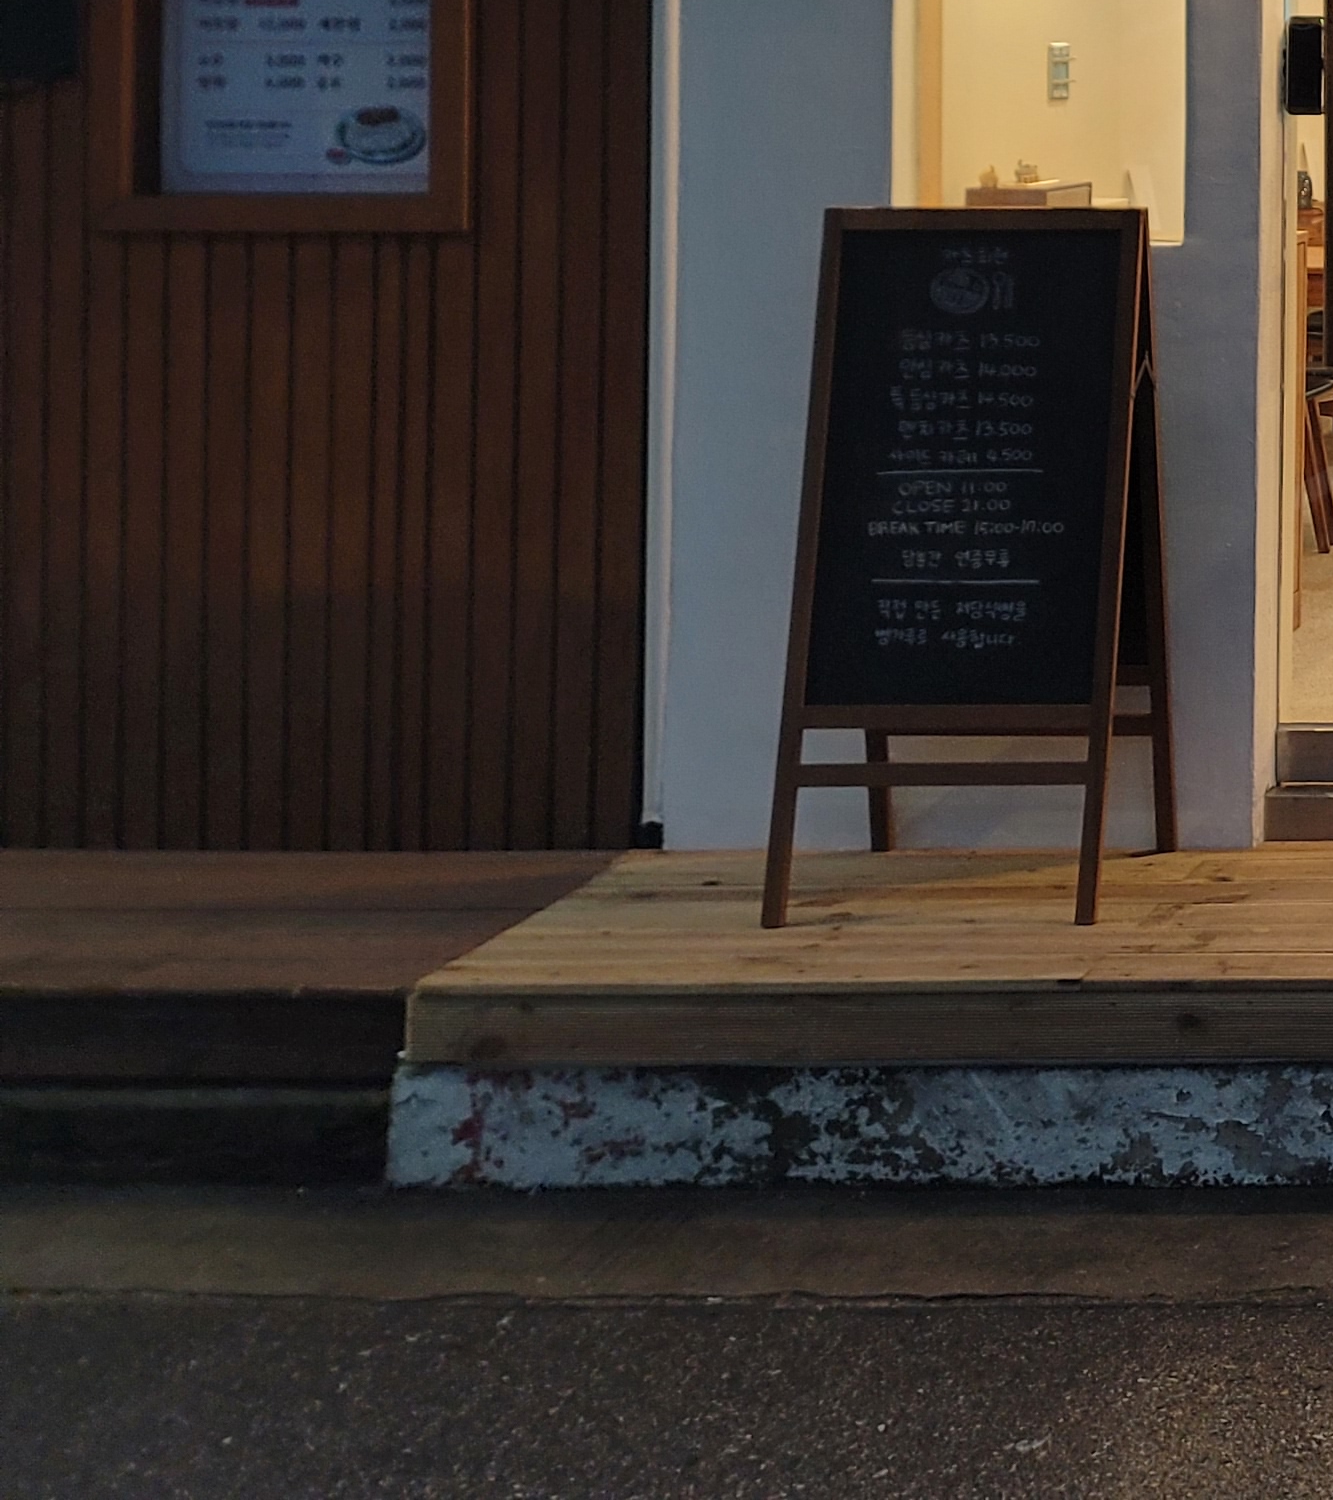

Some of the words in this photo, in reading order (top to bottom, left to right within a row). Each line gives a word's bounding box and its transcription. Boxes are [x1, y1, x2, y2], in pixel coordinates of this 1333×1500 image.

[898, 480, 952, 497] OPEN
[892, 498, 956, 515] CLOSE
[867, 520, 920, 537] BREAK
[923, 520, 967, 536] TIME
